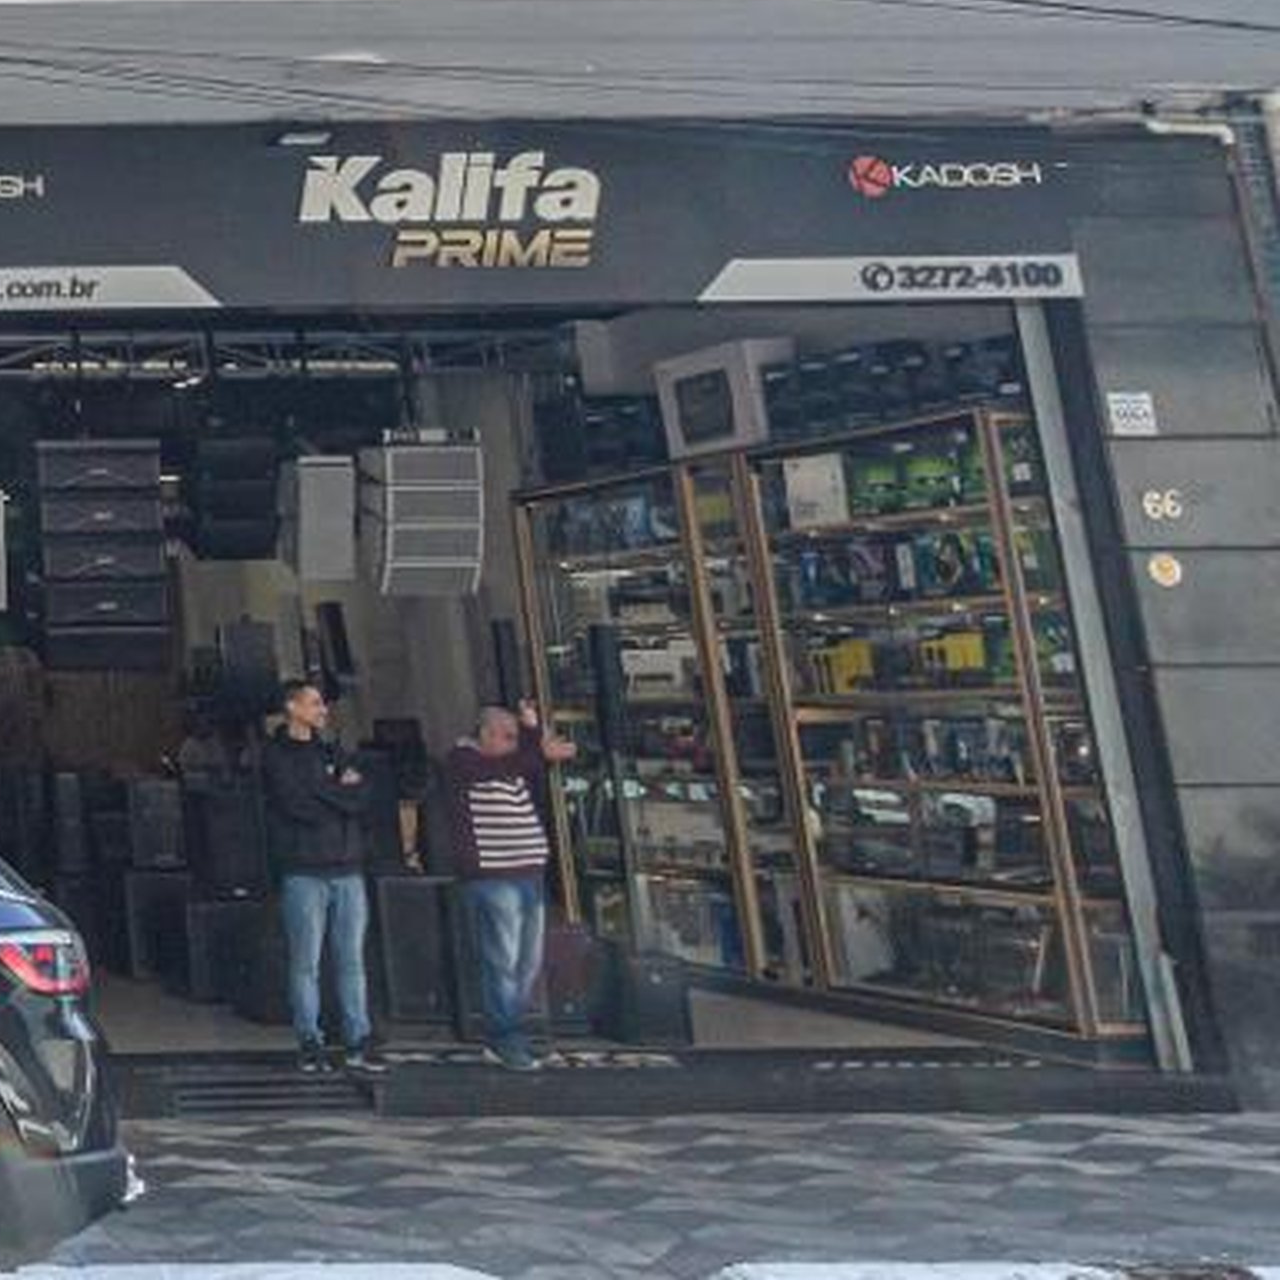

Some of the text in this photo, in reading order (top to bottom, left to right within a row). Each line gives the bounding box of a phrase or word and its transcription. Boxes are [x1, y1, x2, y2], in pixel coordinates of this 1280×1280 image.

[299, 151, 601, 222] Kalifa
[892, 162, 1041, 187] KADOSH
[393, 229, 593, 267] PRIME
[1142, 488, 1183, 519] 66
